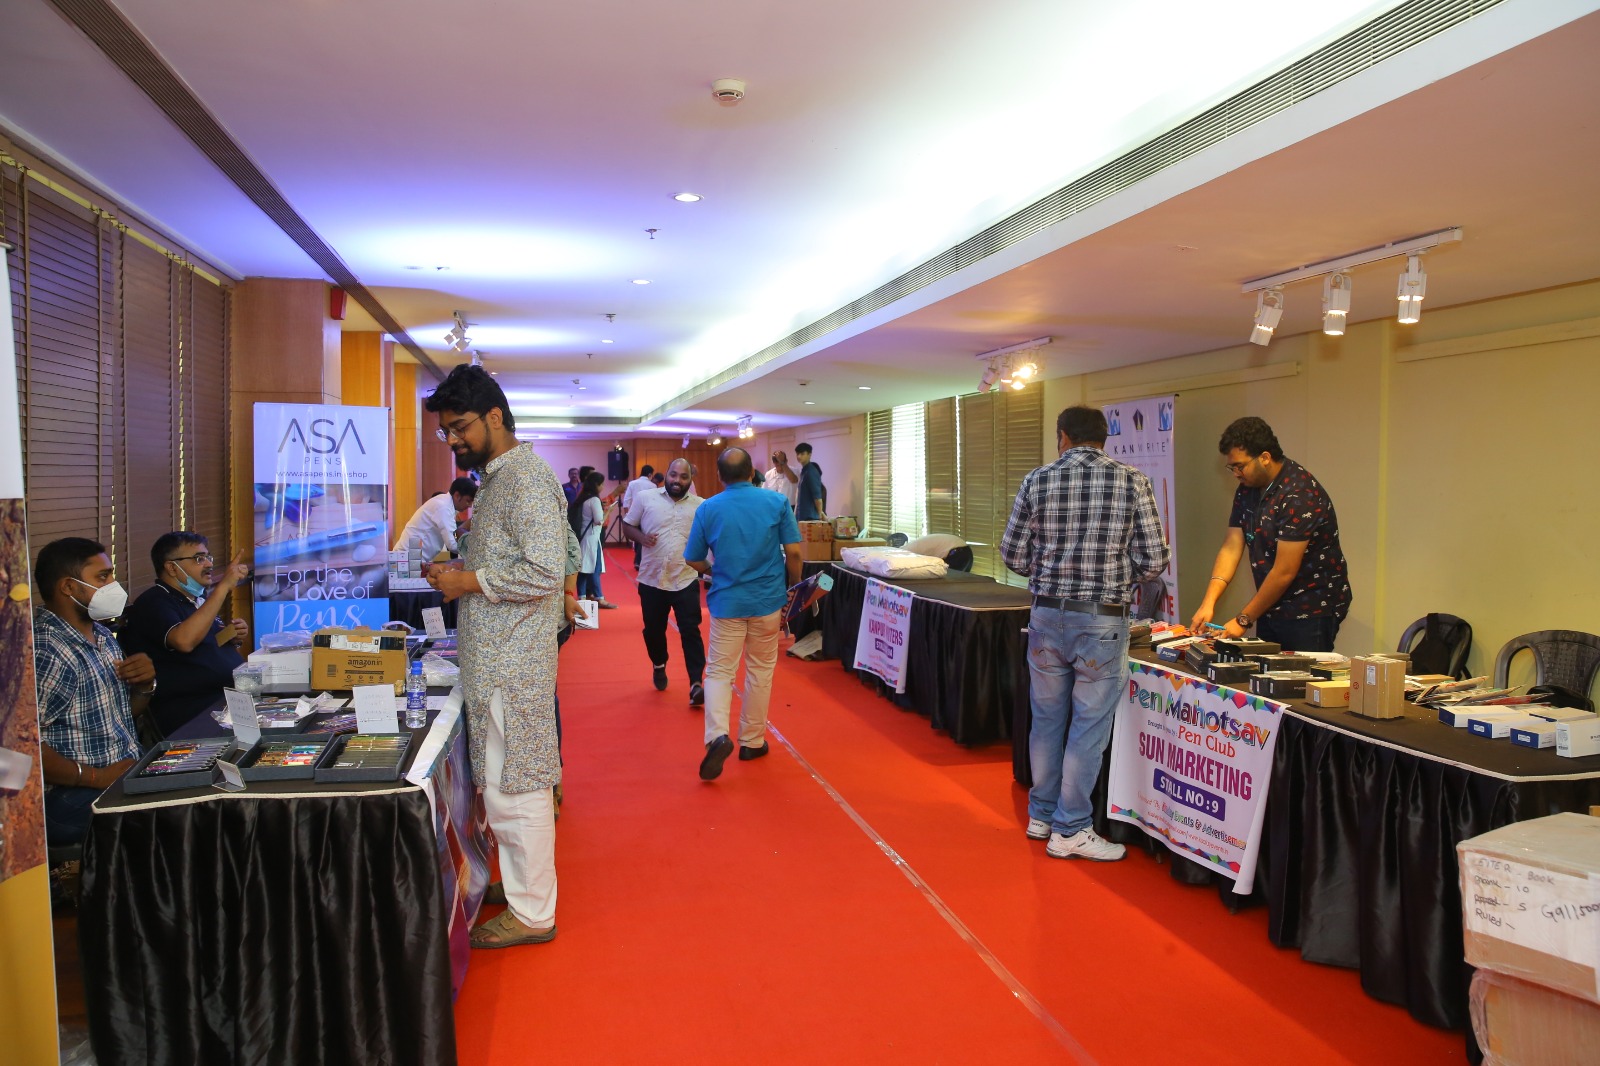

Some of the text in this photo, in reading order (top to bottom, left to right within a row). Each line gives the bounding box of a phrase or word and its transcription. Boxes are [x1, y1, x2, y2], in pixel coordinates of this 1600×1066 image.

[277, 418, 366, 455] ASA
[1114, 441, 1166, 455] KANWRITE
[304, 456, 342, 466] PENS
[274, 563, 353, 584] For the
[294, 580, 374, 601] Love of
[272, 603, 365, 633] Pens
[1129, 679, 1271, 750] Pen Mahotsav
[1178, 725, 1202, 746] Pen
[1205, 735, 1236, 758] Club
[1139, 732, 1252, 801] SUN MARKETING
[1160, 775, 1183, 800] STALL
[1475, 908, 1502, 927] Ruled
